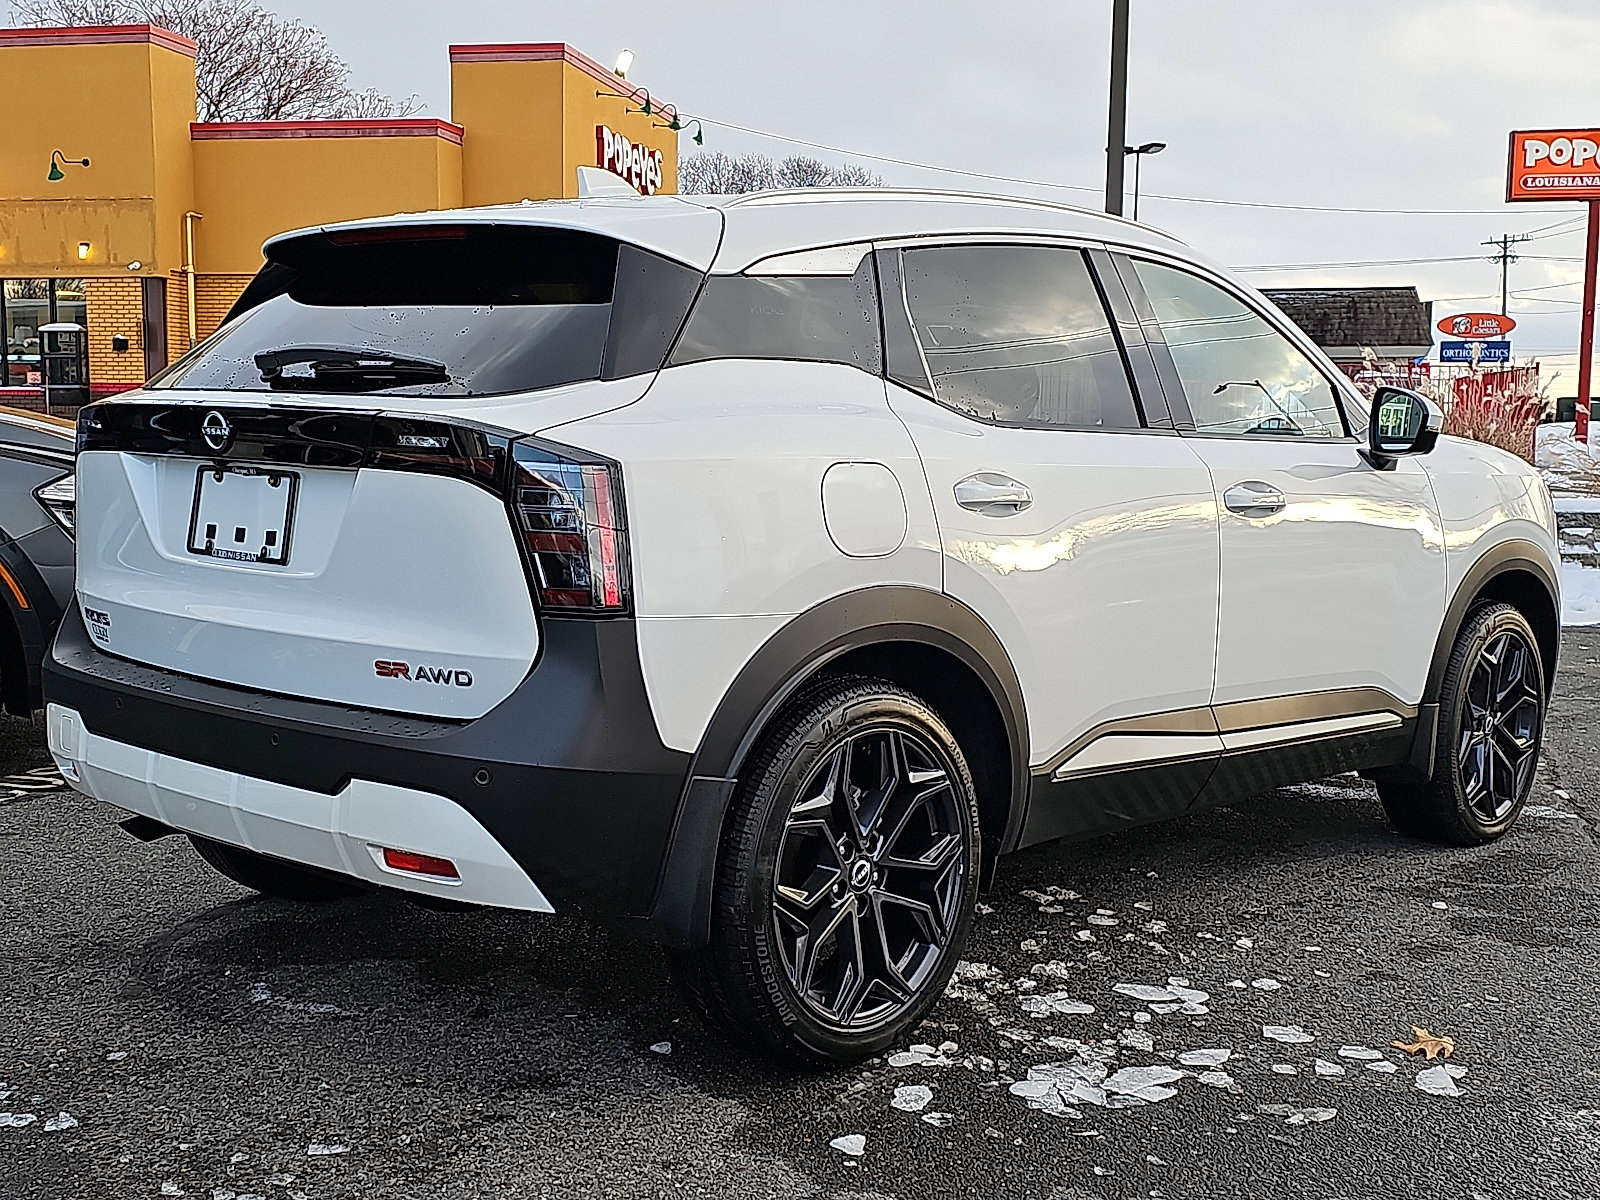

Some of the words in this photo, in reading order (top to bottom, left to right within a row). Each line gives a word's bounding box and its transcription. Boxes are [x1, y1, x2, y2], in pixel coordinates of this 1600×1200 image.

[1522, 137, 1600, 168] POP
[1526, 176, 1600, 187] LOUISIANA
[1478, 318, 1500, 328] Little
[1471, 326, 1502, 334] Caesars
[1442, 348, 1509, 358] ORTHONTICS
[227, 551, 257, 562] NISSAN
[374, 660, 412, 681] SR
[414, 665, 473, 687] AWD
[753, 924, 798, 1027] BRIDGESTONE
